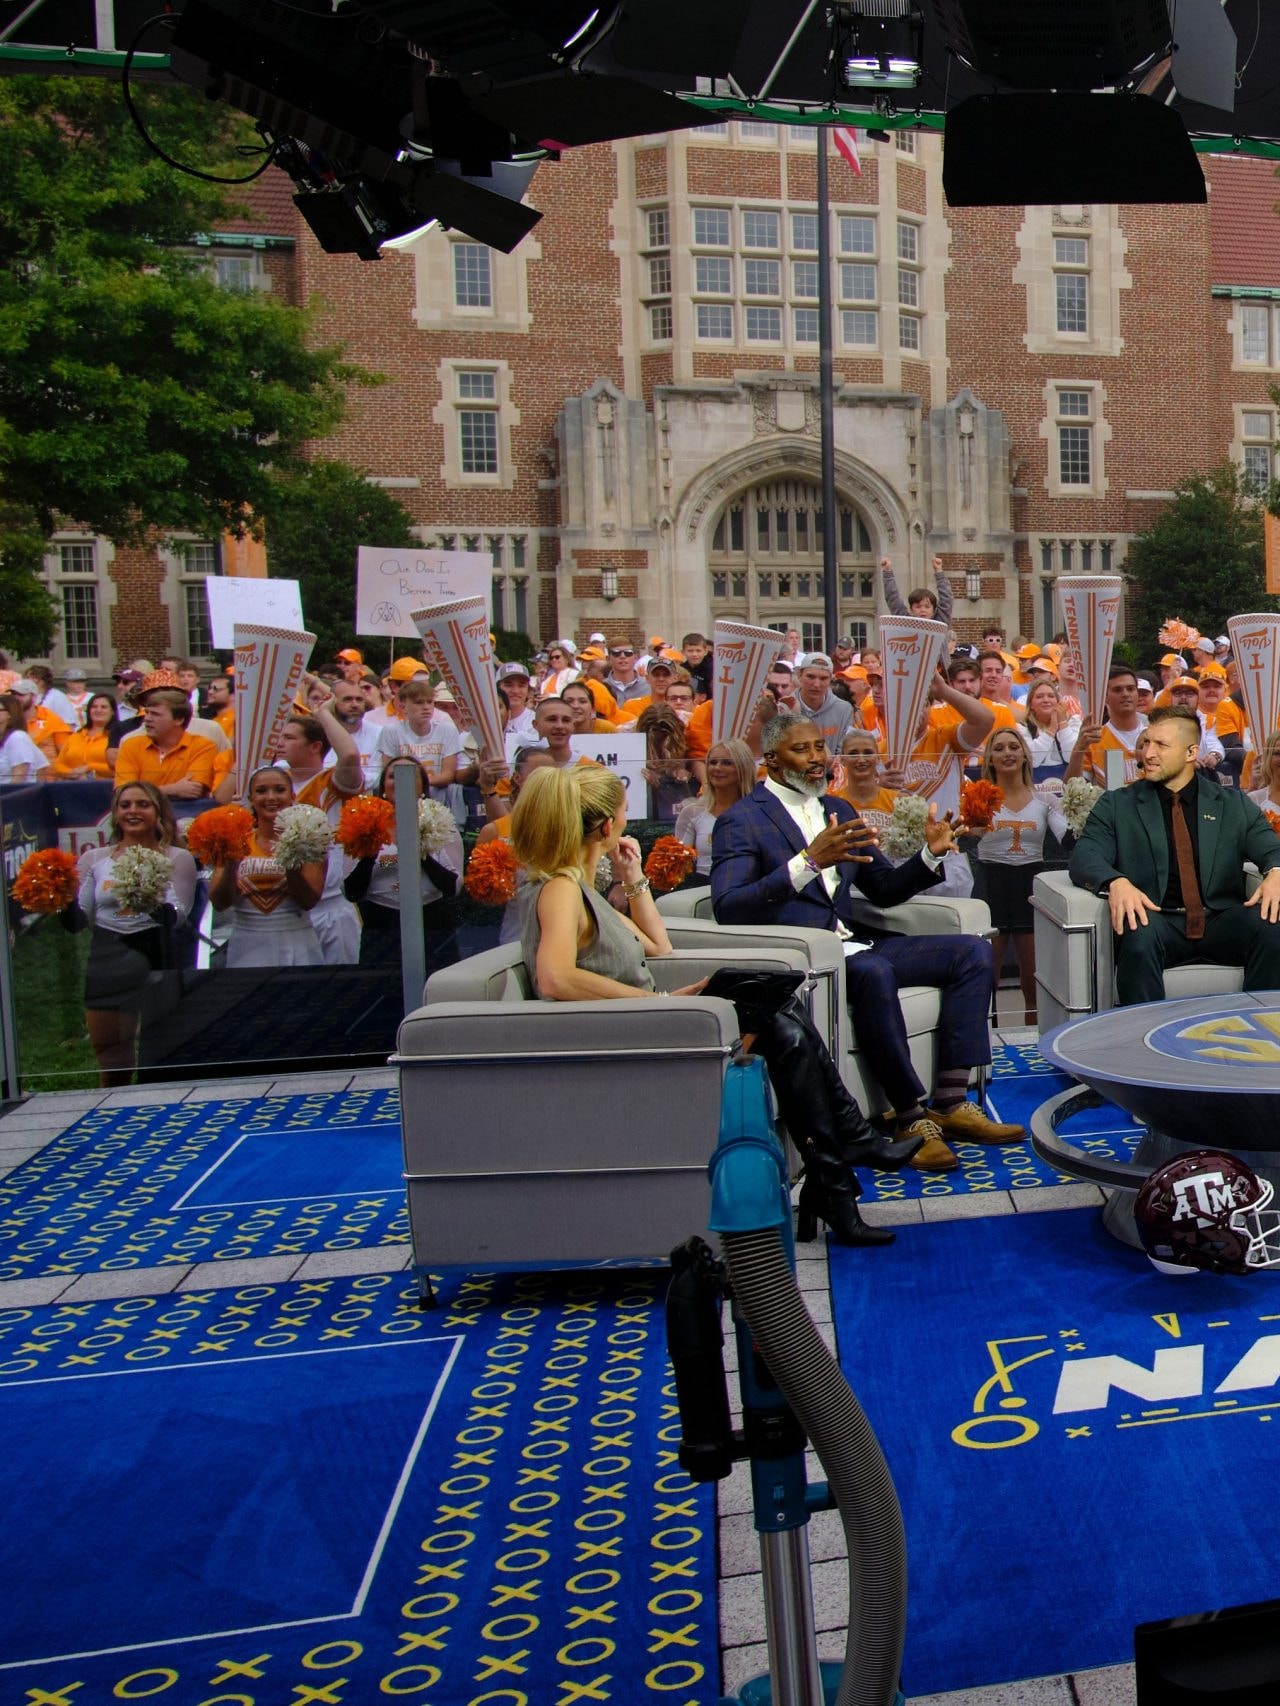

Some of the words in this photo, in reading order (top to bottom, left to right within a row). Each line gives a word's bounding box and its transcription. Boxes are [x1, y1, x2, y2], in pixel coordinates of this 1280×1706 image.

[423, 628, 476, 727] TENNESSEE
[1064, 595, 1088, 693] TENNESSEE
[262, 692, 292, 761] ROCKY
[285, 652, 305, 689] TOP
[996, 819, 1038, 853] T
